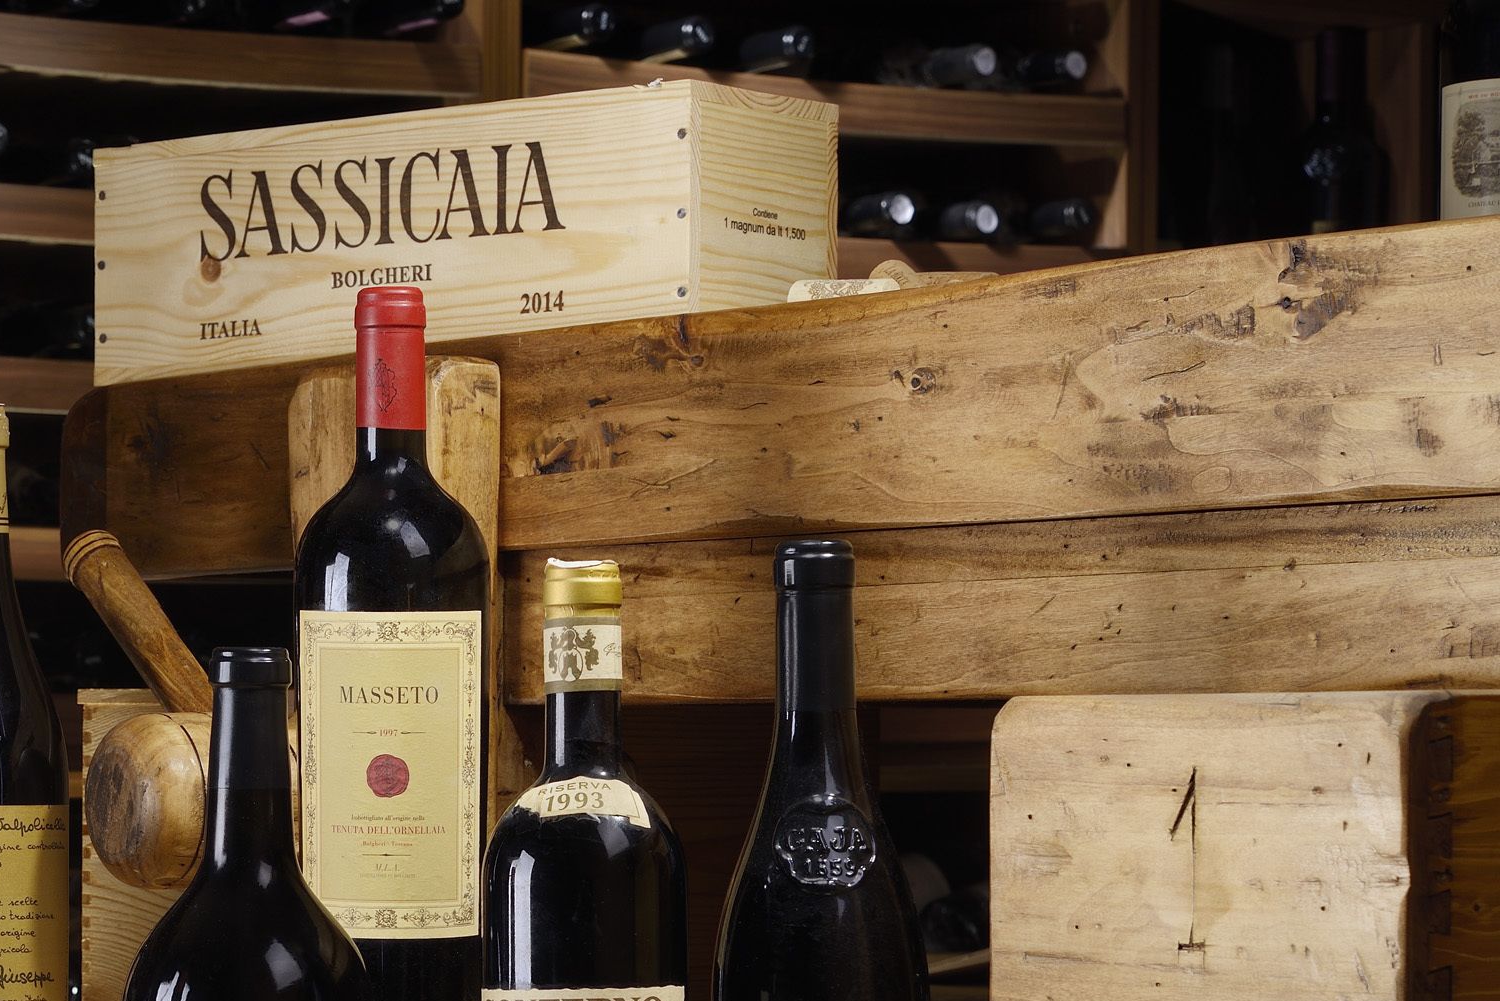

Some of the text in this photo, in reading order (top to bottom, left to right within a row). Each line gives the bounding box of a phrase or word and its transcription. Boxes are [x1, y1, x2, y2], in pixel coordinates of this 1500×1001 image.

[199, 141, 567, 264] SASSICAIA
[752, 207, 779, 221] Contiene
[723, 217, 729, 229] 1
[730, 218, 765, 235] magnum
[766, 223, 776, 237] da
[785, 226, 807, 241] 1,500
[331, 262, 433, 289] BOLGHERI
[519, 289, 565, 315] 2014
[199, 318, 262, 341] ITALIA
[339, 685, 440, 706] MASSETO
[379, 728, 399, 738] 1997
[538, 780, 612, 796] RISERVA
[545, 791, 605, 813] 1993
[331, 824, 447, 835] TENUTA DELL'ORNELLAIA
